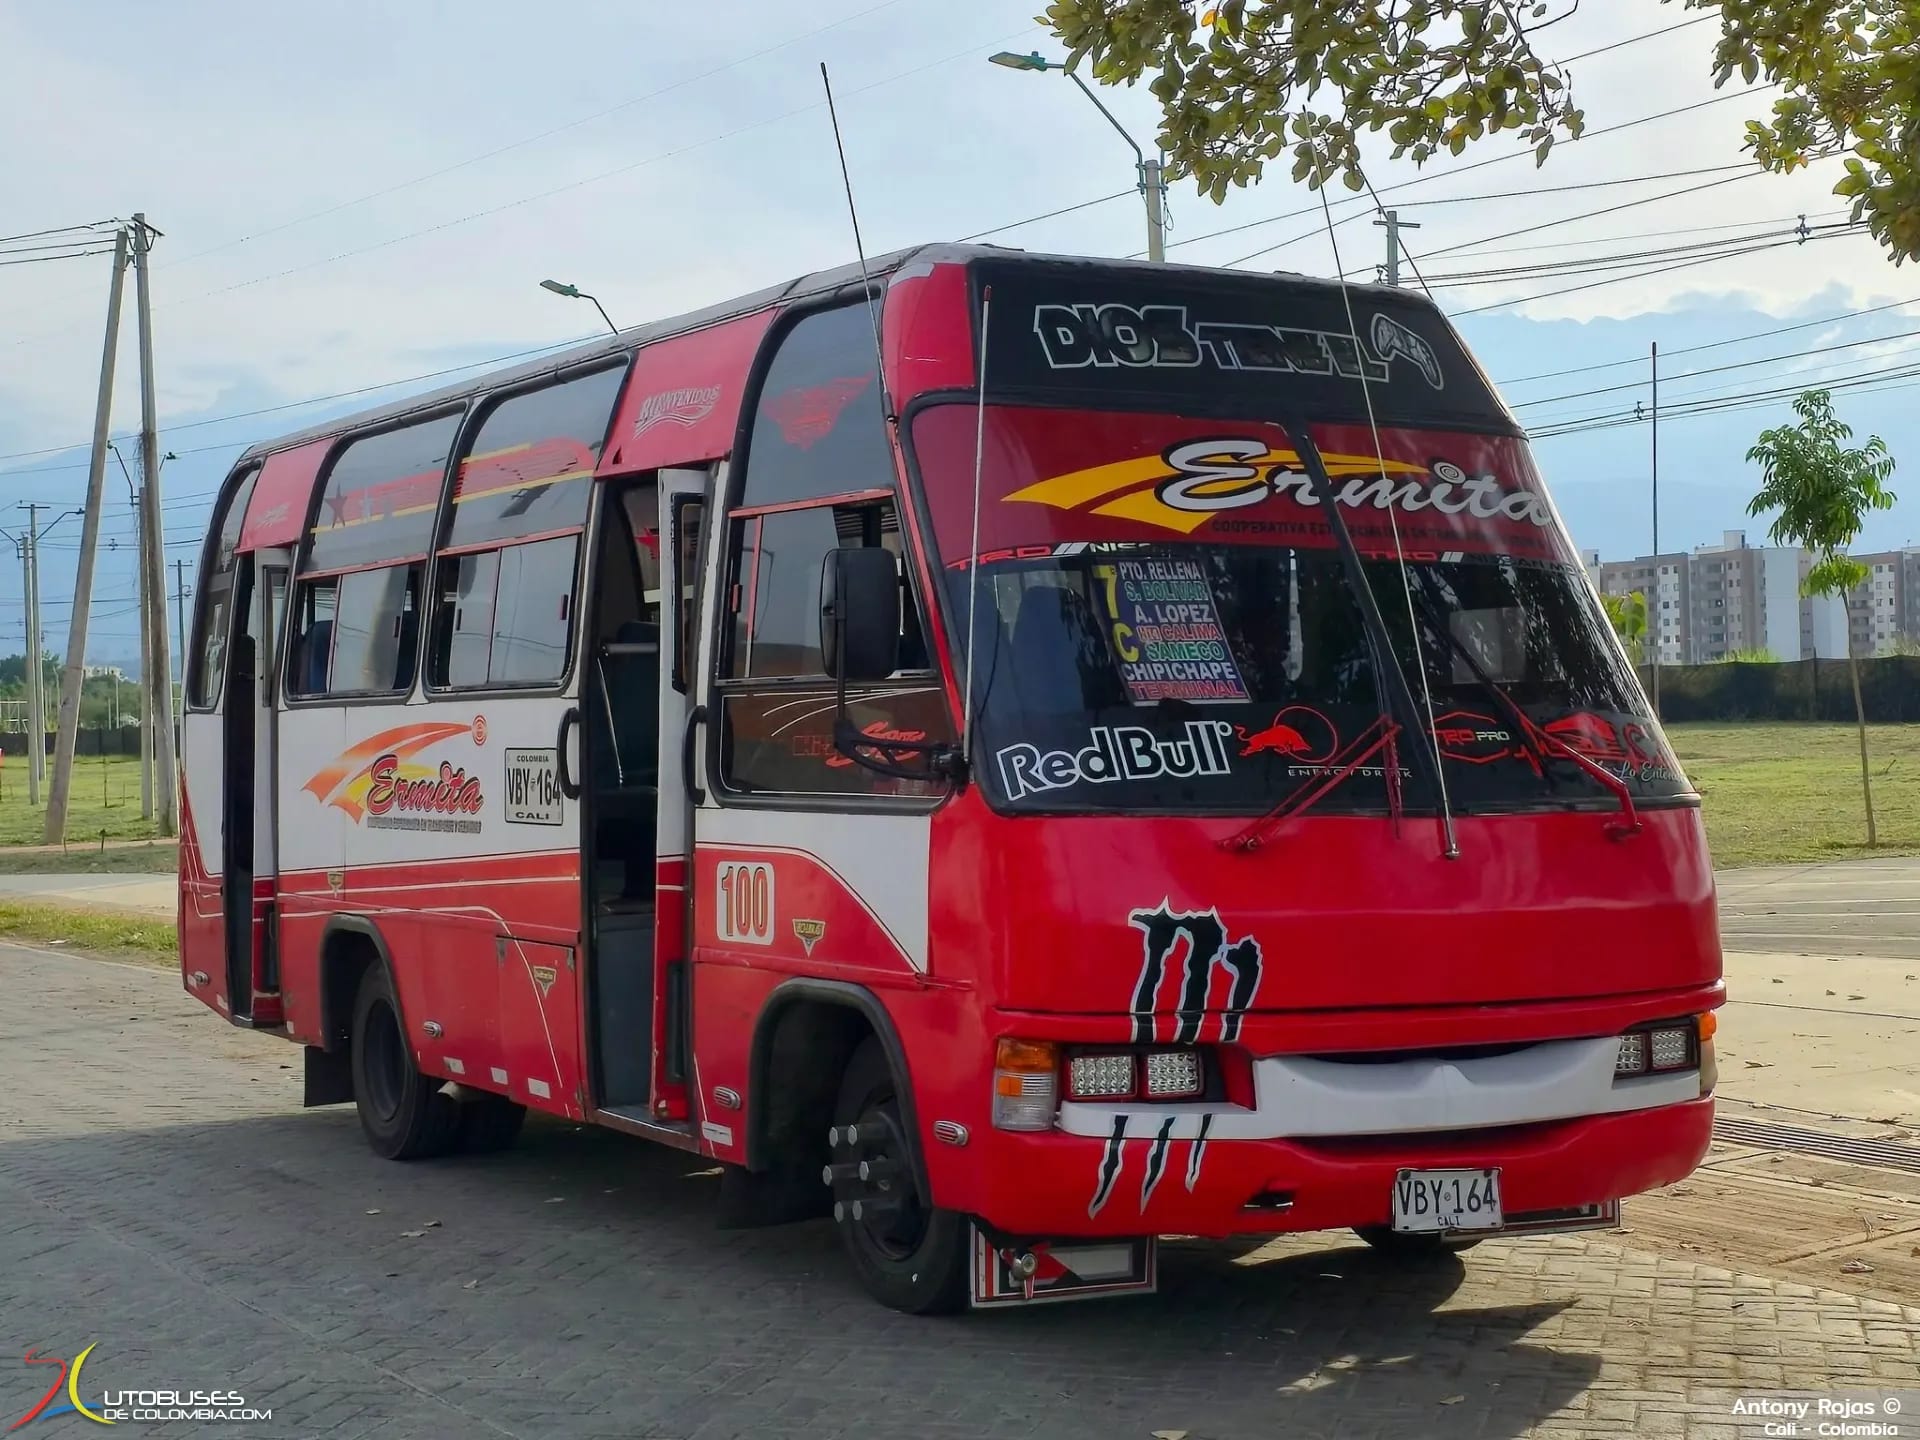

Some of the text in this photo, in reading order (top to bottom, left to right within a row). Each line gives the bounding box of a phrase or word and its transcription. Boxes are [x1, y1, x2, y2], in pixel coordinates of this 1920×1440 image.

[1034, 303, 1201, 368] DIOS
[1157, 437, 1555, 526] Ermita
[1119, 562, 1202, 580] PTO. RELLENA
[1092, 565, 1119, 619] 7
[1141, 581, 1209, 601] BOLIVAR
[1135, 604, 1214, 623] A. LOPEZ
[1113, 622, 1139, 662] C
[1161, 624, 1223, 641] CALIMA
[1145, 641, 1225, 661] SAMECO
[1121, 662, 1237, 680] CHIPICHAPE
[1128, 680, 1246, 700] TERMINAL
[1475, 731, 1511, 742] PRO
[1362, 769, 1413, 778] DRK
[367, 754, 485, 816] Ermita
[508, 768, 560, 806] VBY 164
[515, 812, 549, 820] CALI
[721, 865, 769, 937] 100
[1398, 1178, 1496, 1215] VBY 164
[1438, 1215, 1460, 1226] CALI
